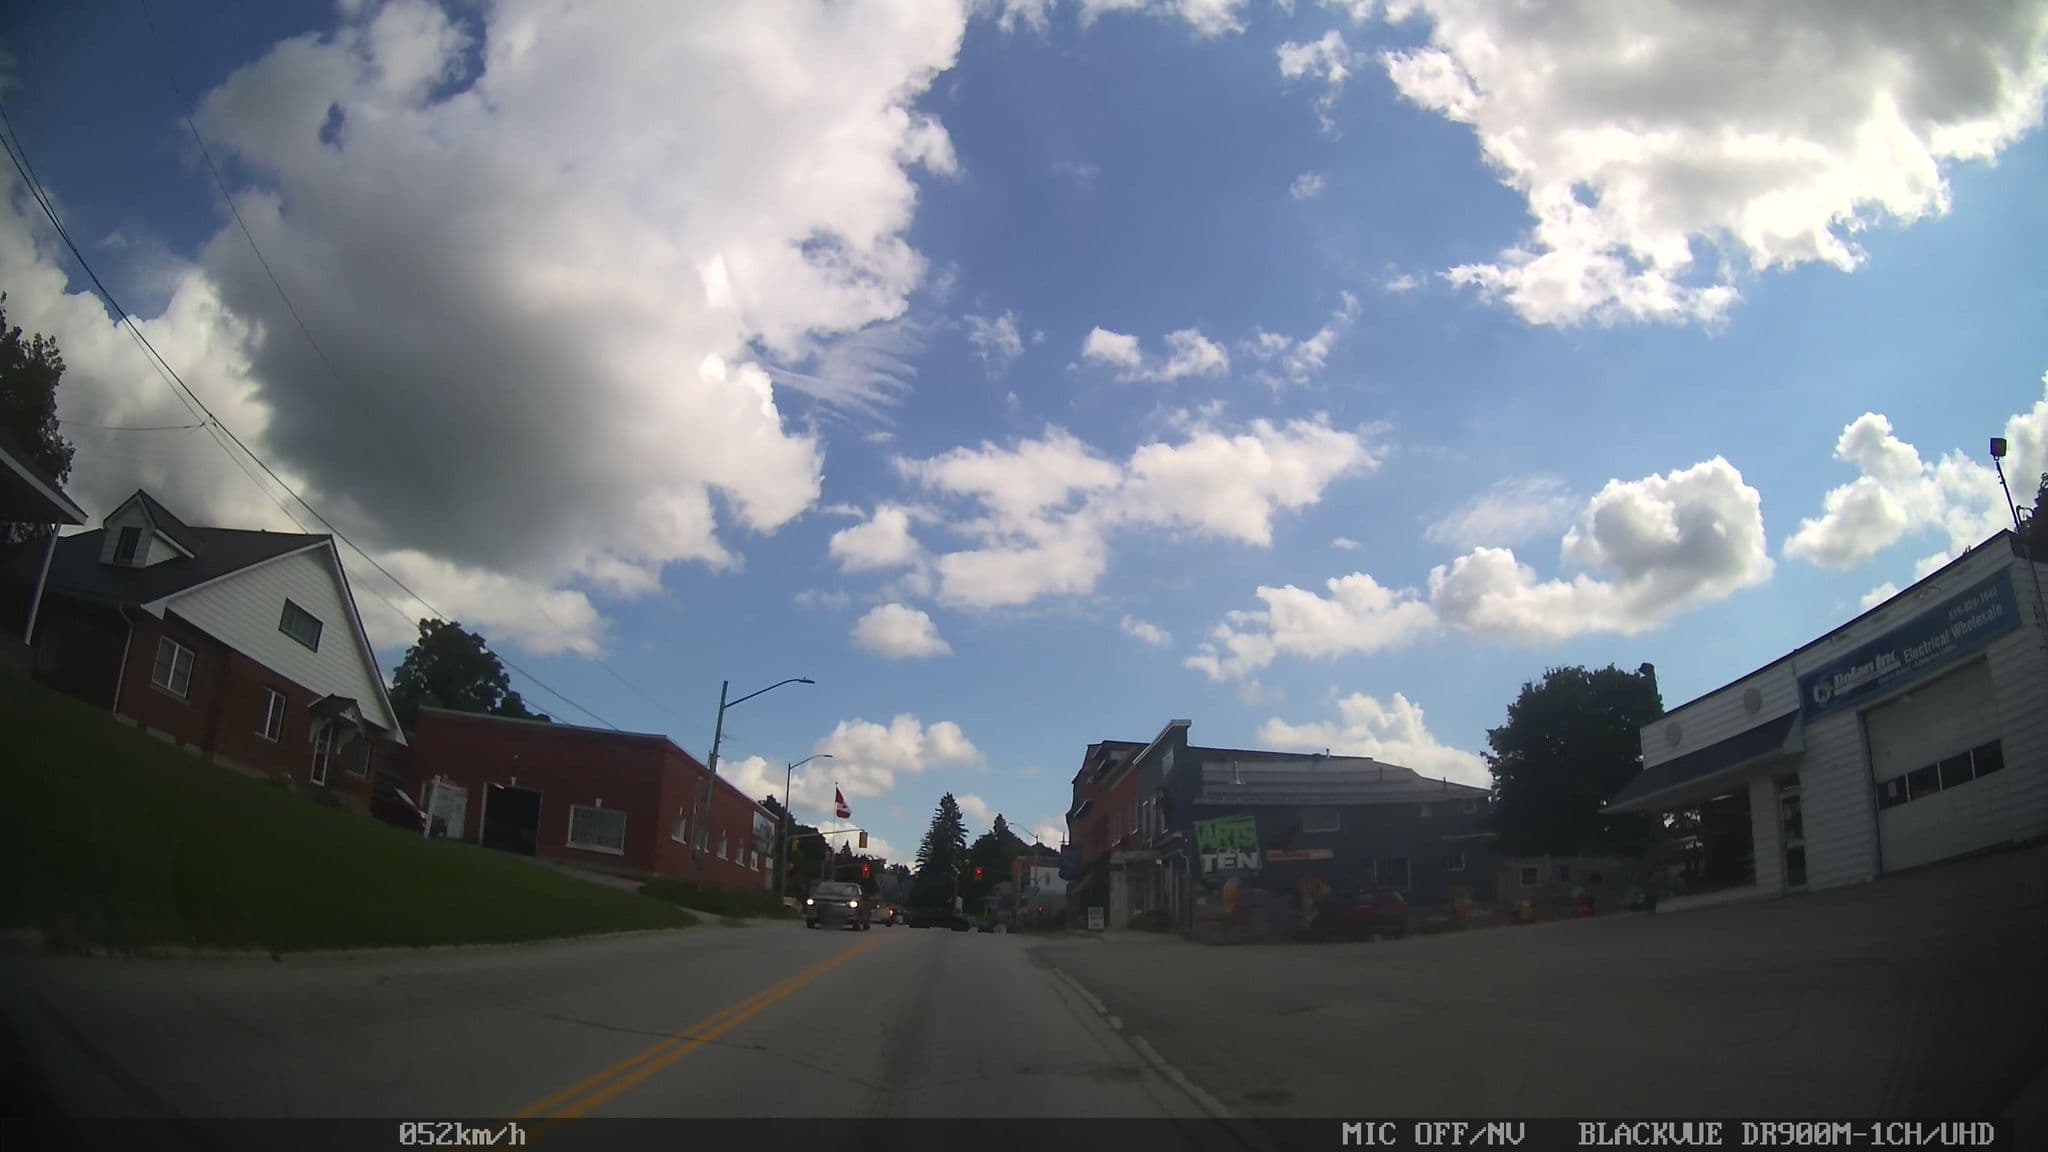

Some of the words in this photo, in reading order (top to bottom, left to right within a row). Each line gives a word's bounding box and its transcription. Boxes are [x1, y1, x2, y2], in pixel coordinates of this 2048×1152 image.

[1903, 627, 1950, 663] Electrical
[1950, 602, 2002, 639] Wholesale
[1198, 820, 1257, 849] ARTS
[1200, 852, 1259, 872] TEN
